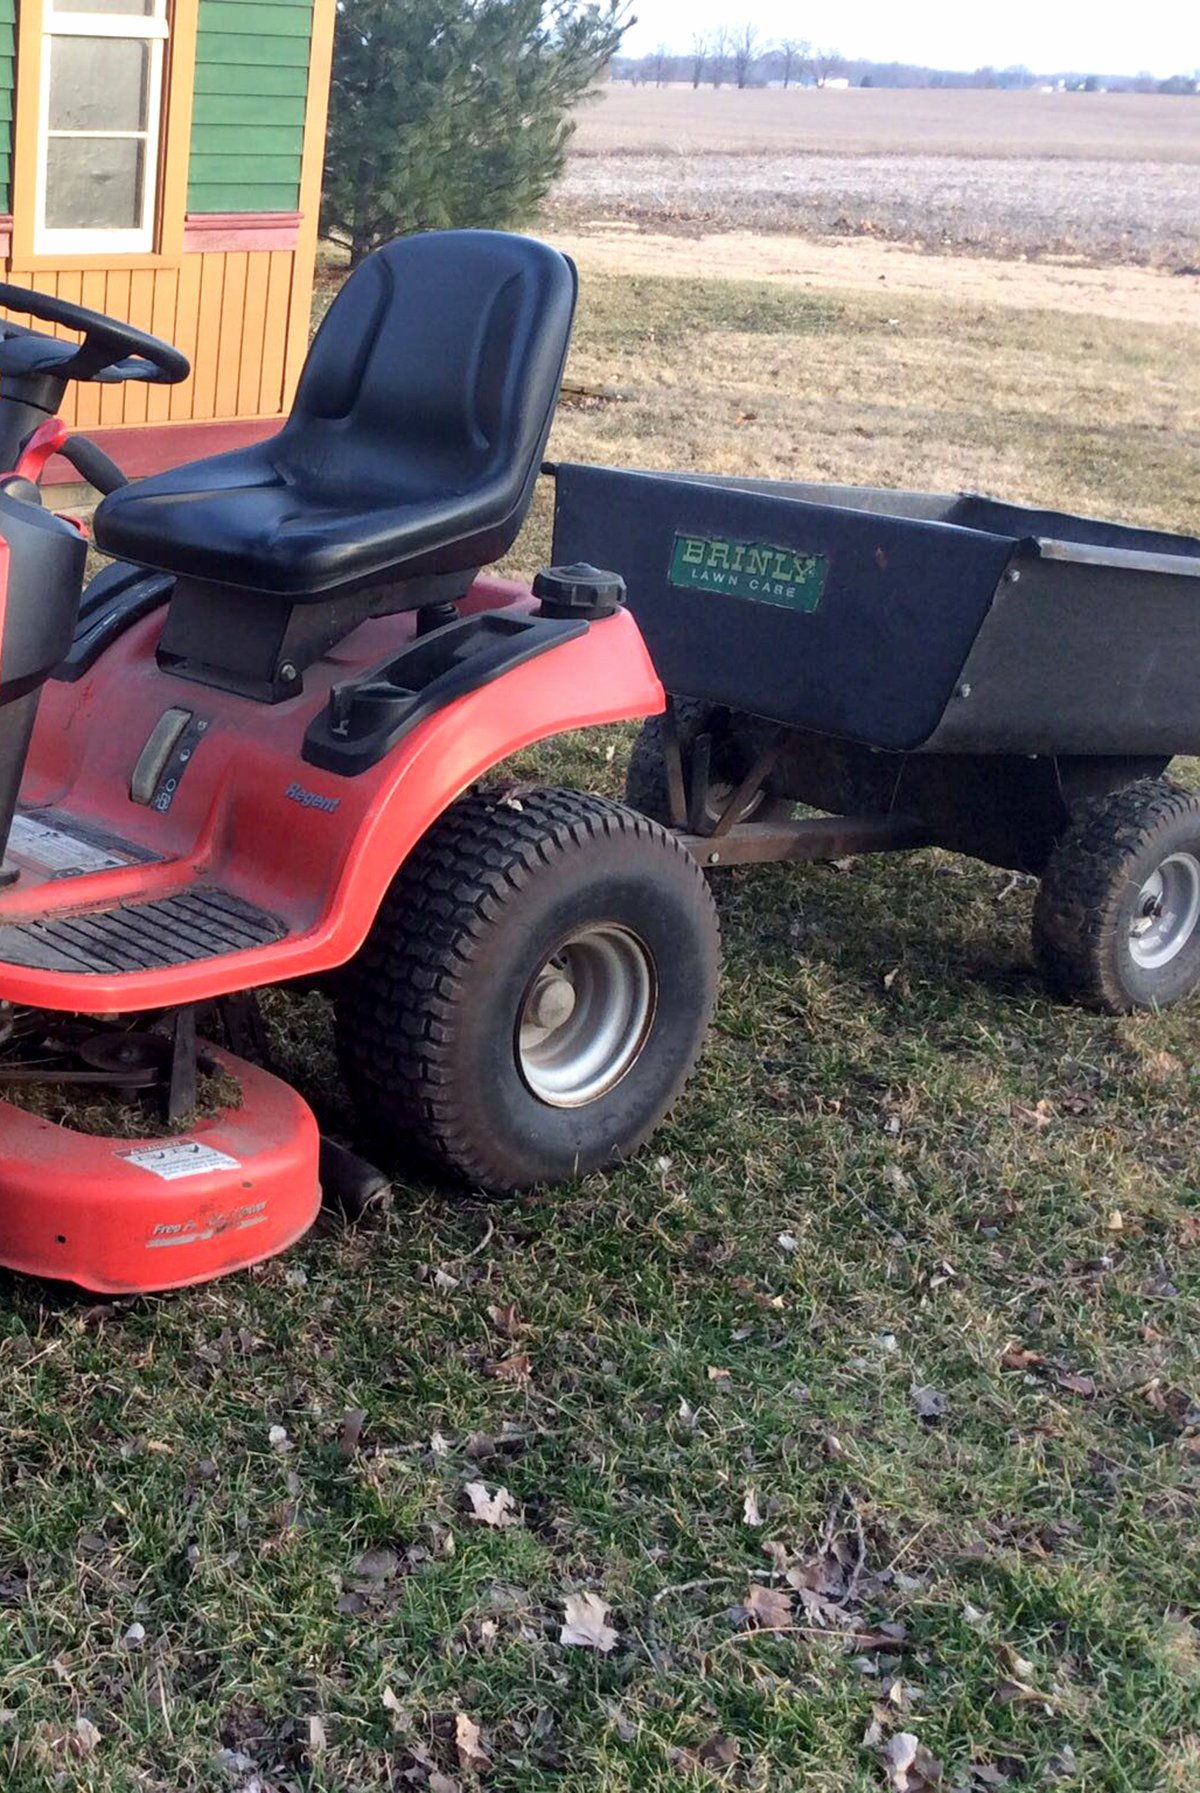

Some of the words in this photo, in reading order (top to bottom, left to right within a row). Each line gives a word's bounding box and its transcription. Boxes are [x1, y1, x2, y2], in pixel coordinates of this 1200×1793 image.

[682, 539, 817, 584] BRINLY
[691, 569, 739, 586] LAWN
[749, 579, 797, 598] CARE
[285, 783, 341, 812] Regent
